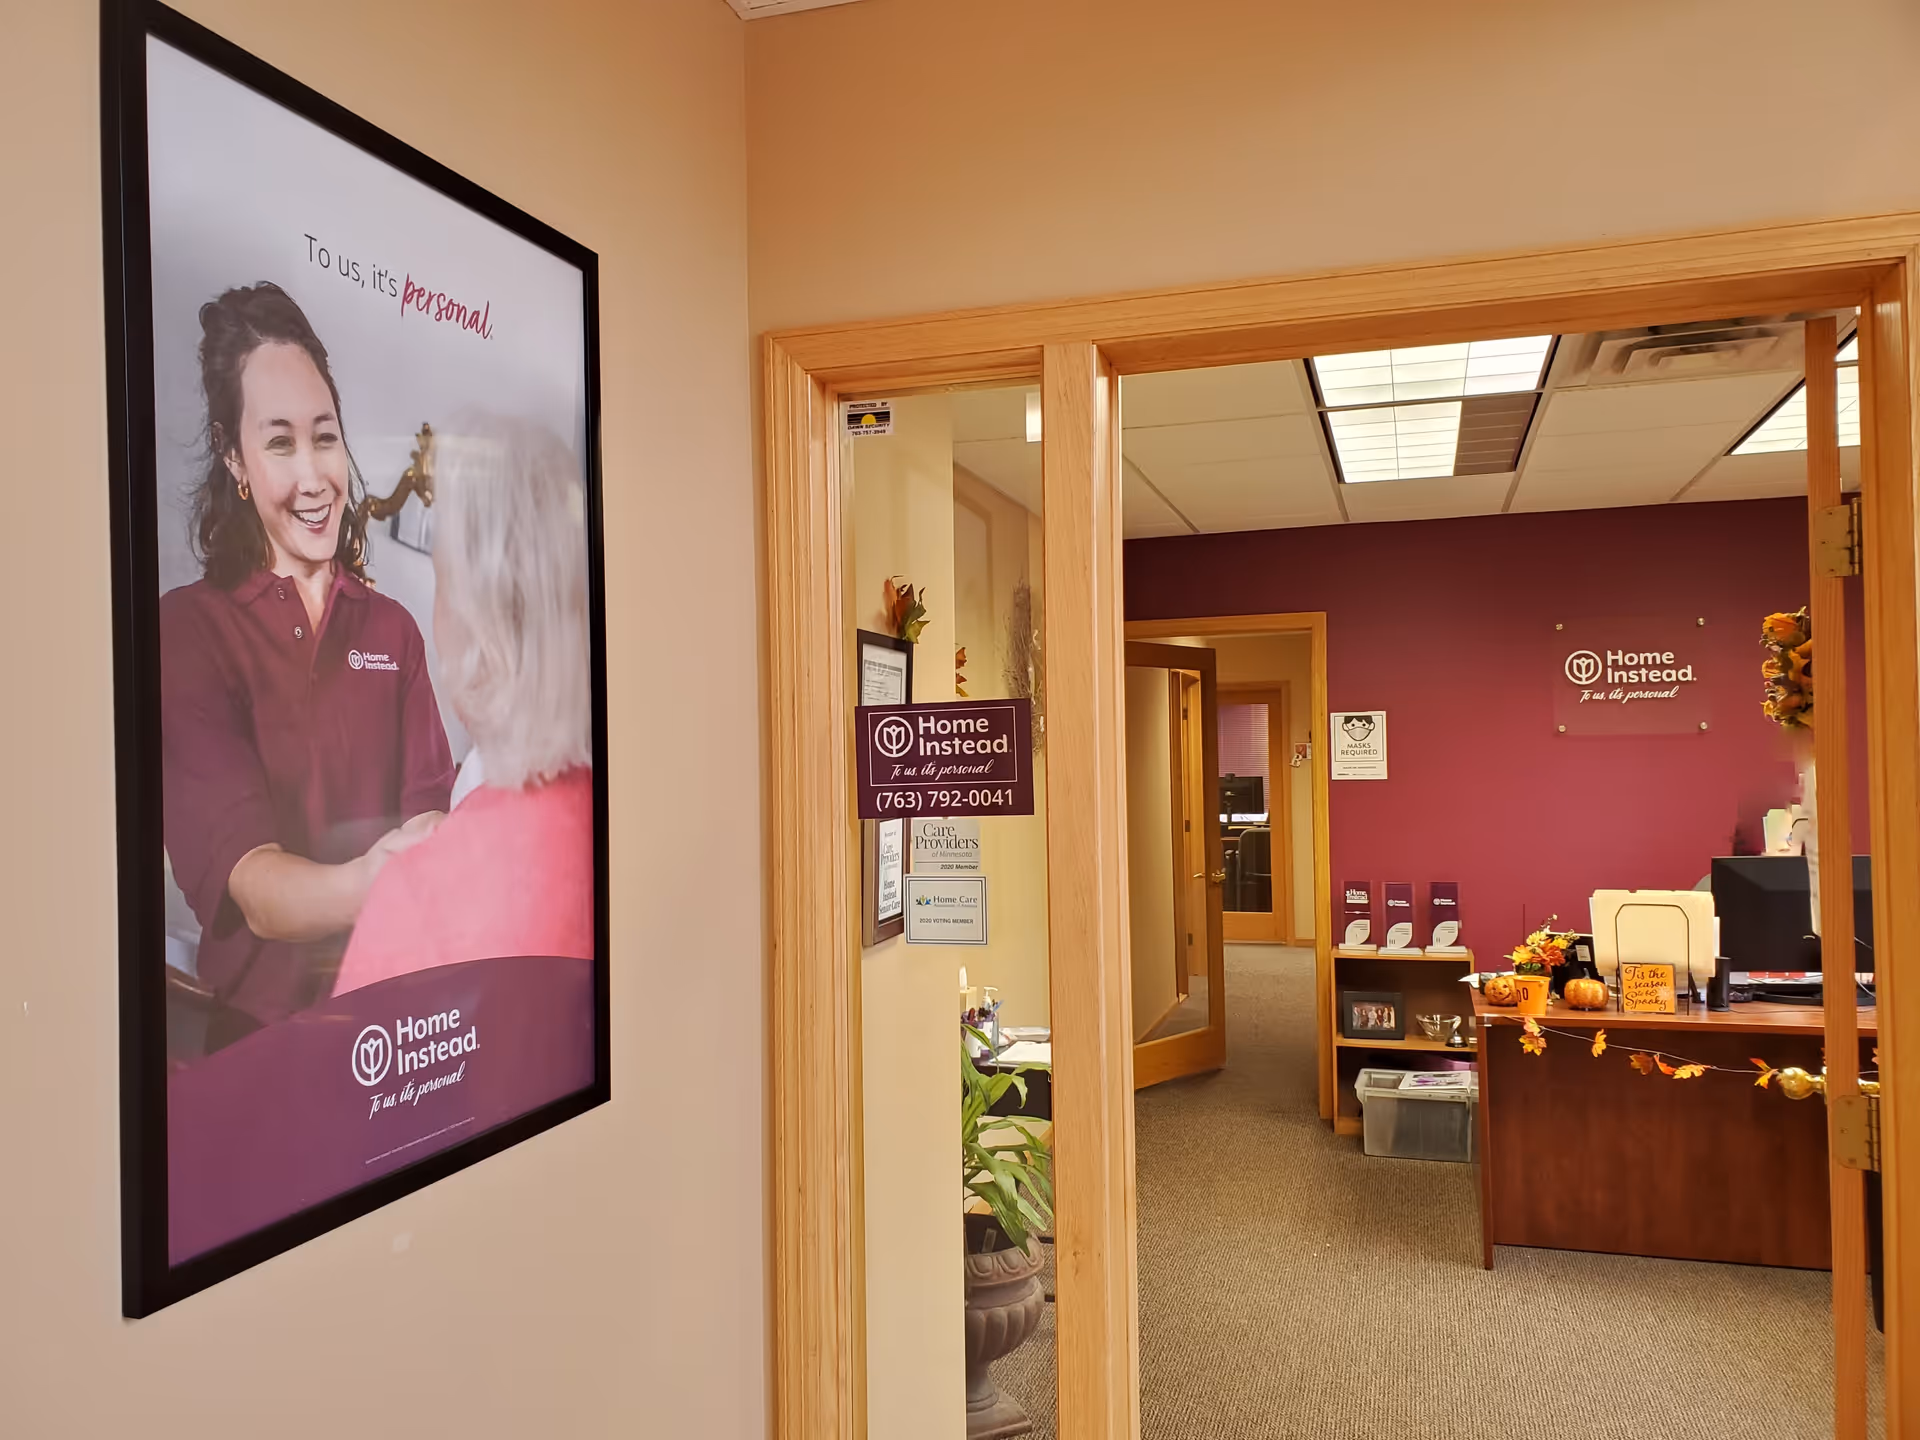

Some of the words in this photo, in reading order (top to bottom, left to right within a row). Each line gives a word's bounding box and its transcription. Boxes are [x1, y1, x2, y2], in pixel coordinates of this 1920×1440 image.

[304, 233, 331, 268] To
[338, 254, 365, 288] us,
[372, 263, 398, 298] it's
[362, 652, 390, 662] Home
[1606, 649, 1675, 666] Home
[1579, 689, 1593, 704] To
[1608, 686, 1624, 700] it's
[1621, 685, 1680, 704] personal
[918, 715, 989, 736] Home
[1340, 748, 1378, 757] REQUIRED
[890, 763, 904, 781] To
[904, 766, 918, 777] us,
[920, 760, 937, 776] it's
[934, 758, 995, 781] personal
[876, 791, 923, 812] (763)
[927, 788, 1013, 808] 792-0041
[922, 822, 956, 837] Care
[914, 834, 979, 850] Providers
[931, 850, 939, 858] of
[939, 850, 973, 858] Minnesota
[933, 895, 957, 904] Home
[959, 895, 978, 904] Care
[1648, 968, 1667, 979] the
[1634, 980, 1667, 990] season
[1625, 991, 1667, 1012] Spooky
[396, 1008, 461, 1046] Home
[368, 1092, 384, 1120] To
[400, 1078, 416, 1104] it's
[413, 1060, 466, 1106] personal
